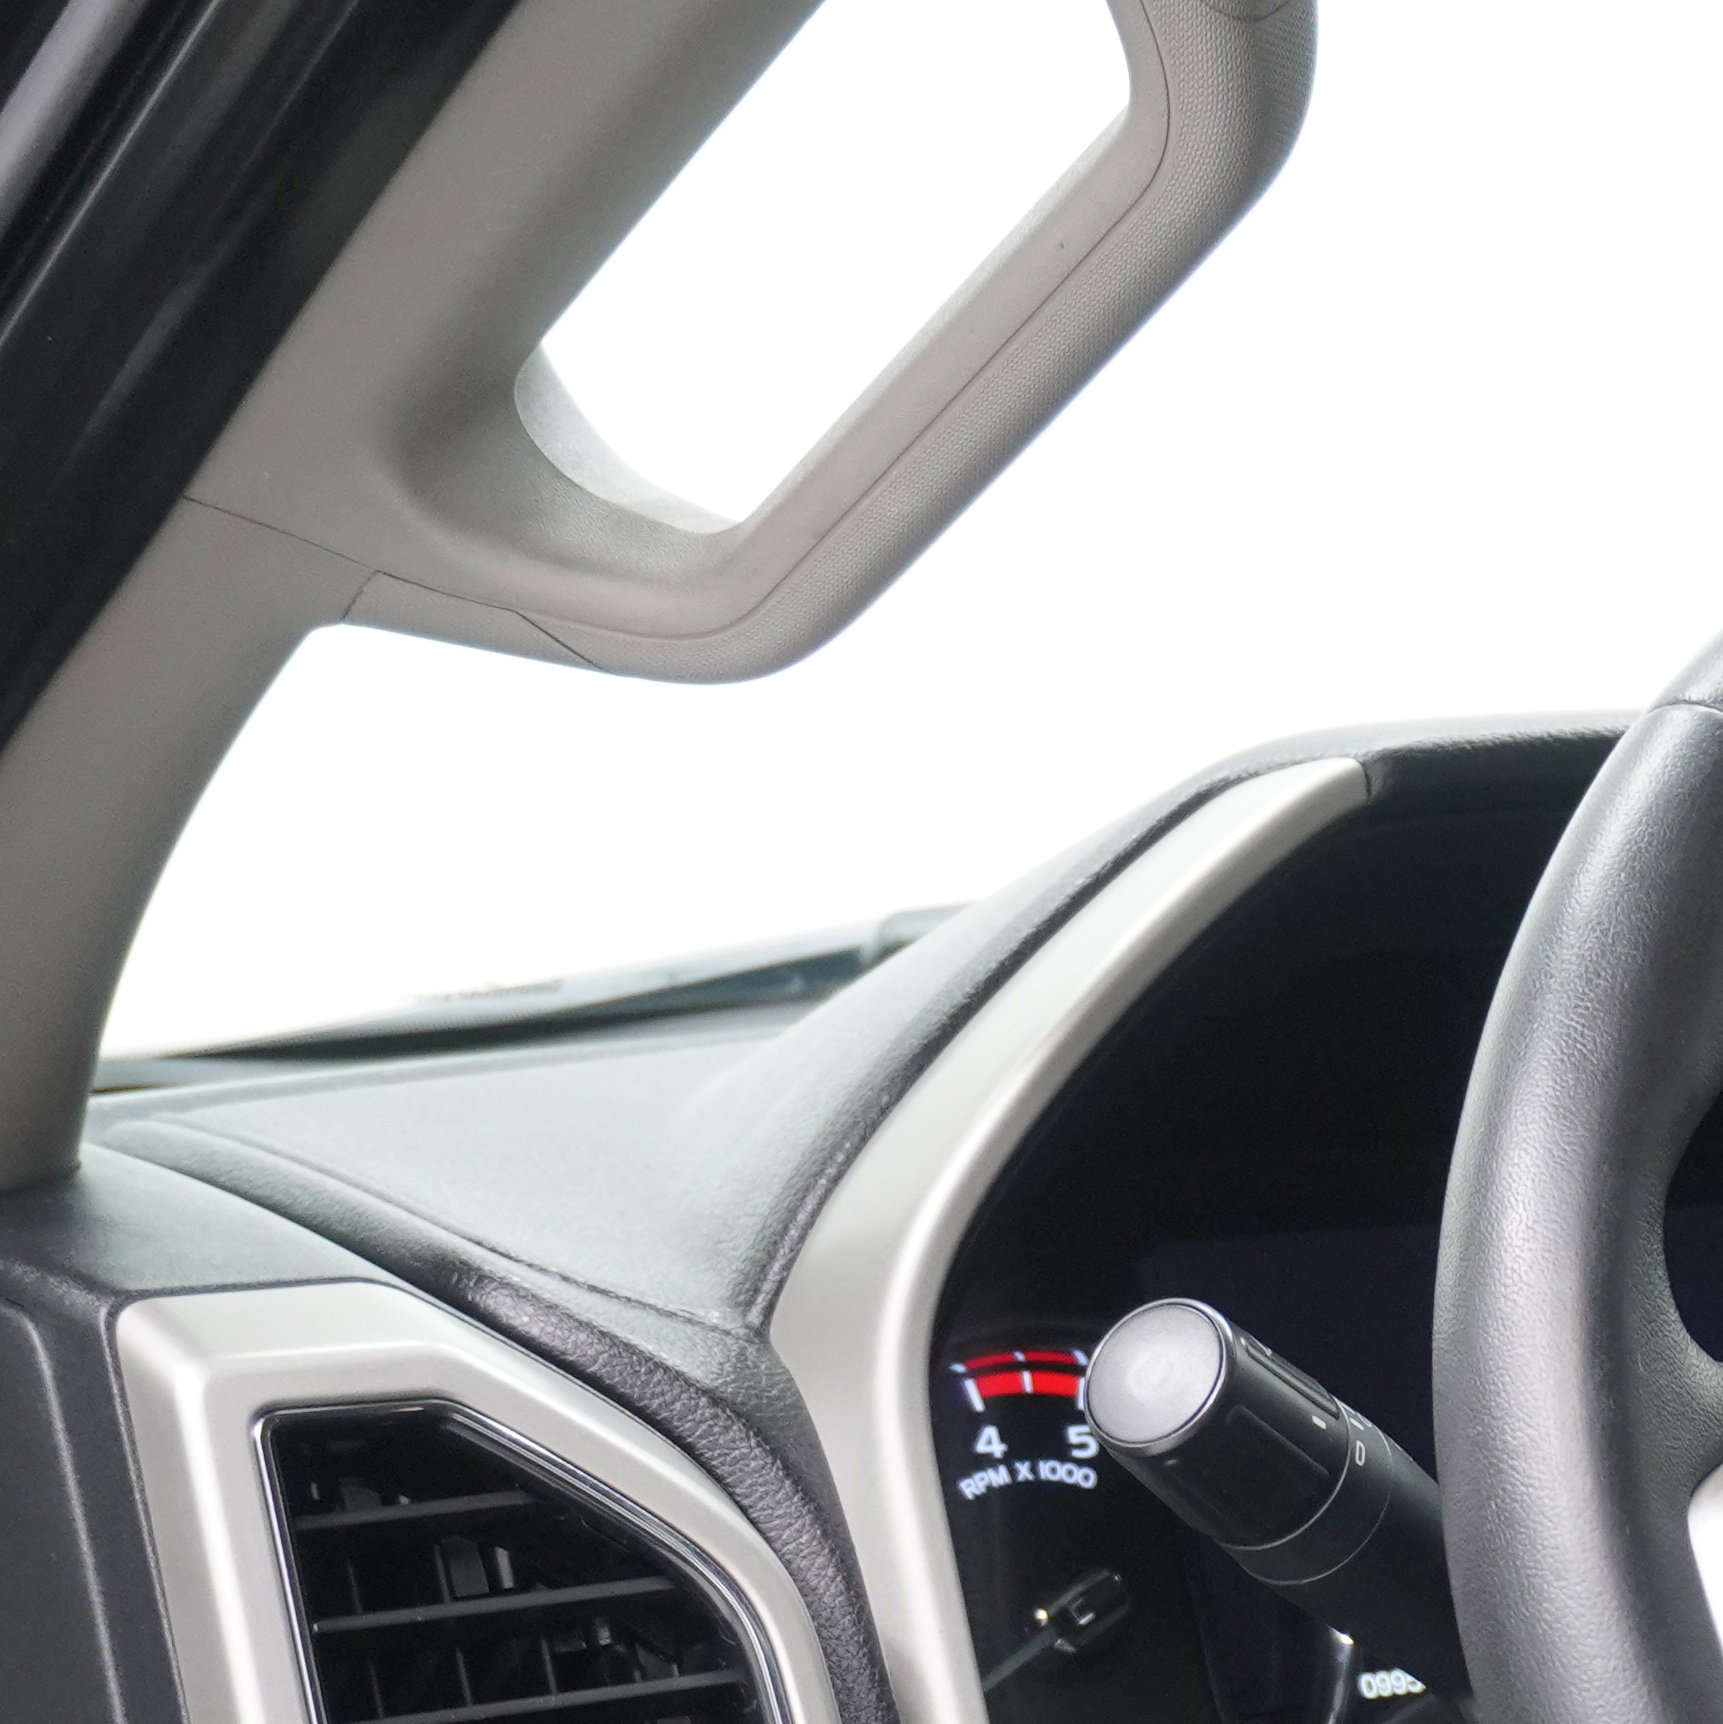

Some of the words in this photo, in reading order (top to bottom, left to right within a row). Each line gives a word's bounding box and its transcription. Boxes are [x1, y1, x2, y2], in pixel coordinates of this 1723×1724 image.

[974, 1424, 1008, 1459] 4
[1066, 1424, 1099, 1459] 5
[958, 1464, 1012, 1499] RPM
[1014, 1460, 1034, 1481] X
[1039, 1459, 1098, 1489] 1000
